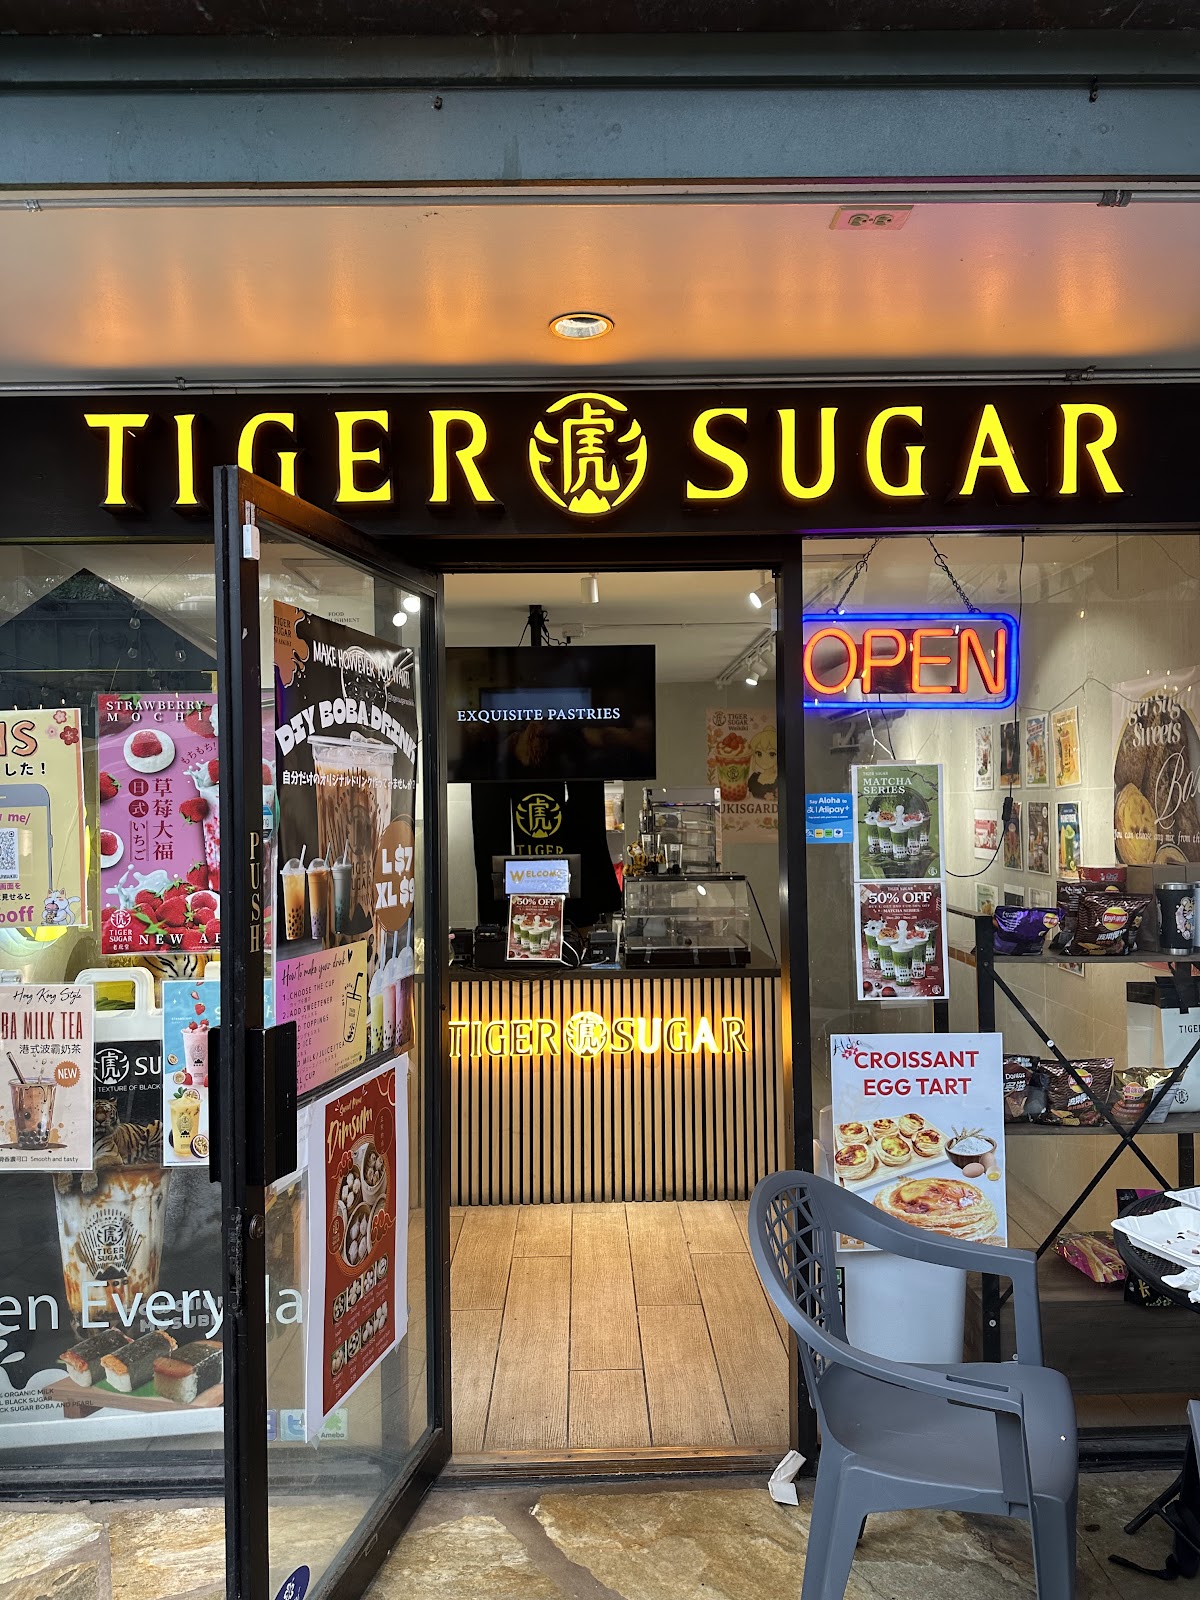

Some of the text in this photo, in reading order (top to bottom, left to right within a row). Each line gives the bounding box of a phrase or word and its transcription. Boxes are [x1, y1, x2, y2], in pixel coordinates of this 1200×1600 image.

[84, 409, 496, 505] TIGER
[686, 403, 1124, 499] SUGAR
[313, 640, 337, 668] MAKE
[338, 649, 376, 679] HOWEVER
[803, 628, 1006, 695] OPEN
[106, 700, 204, 711] STRAWBERRY
[107, 712, 203, 722] MOCHI
[457, 707, 621, 723] EXQUISITE PASTRIES
[275, 705, 316, 757] DIY
[318, 697, 369, 729] BOBA
[1133, 722, 1181, 748] Sweets
[863, 777, 912, 786] MATCHA
[863, 786, 905, 795] SERIES
[152, 778, 173, 861] 草莓大福
[516, 844, 563, 855] TIGER
[249, 831, 261, 954] PUSH
[869, 892, 932, 904] 50% OFF
[538, 898, 556, 906] OFF
[139, 935, 183, 945] NEW
[314, 982, 324, 991] THE
[13, 987, 82, 1005] Hong Kong Style
[303, 996, 333, 1013] SWEETENER
[24, 1012, 54, 1039] MILK
[61, 1012, 83, 1039] TEA
[448, 1019, 560, 1057] TIGER
[610, 1016, 749, 1054] SUGAR
[19, 1044, 82, 1055] 港式波霸奶茶
[854, 1050, 980, 1069] CROISSANT
[57, 1068, 78, 1080] NEW
[98, 1085, 128, 1093] TEXTURE
[139, 1083, 161, 1091] BLACK
[863, 1077, 972, 1096] EGG TART
[97, 1246, 125, 1255] TIGER
[97, 1253, 125, 1262] SUGAR
[4, 1390, 36, 1398] ORGANIC
[56, 1401, 71, 1409] AND
[321, 1431, 345, 1439] Ameba
